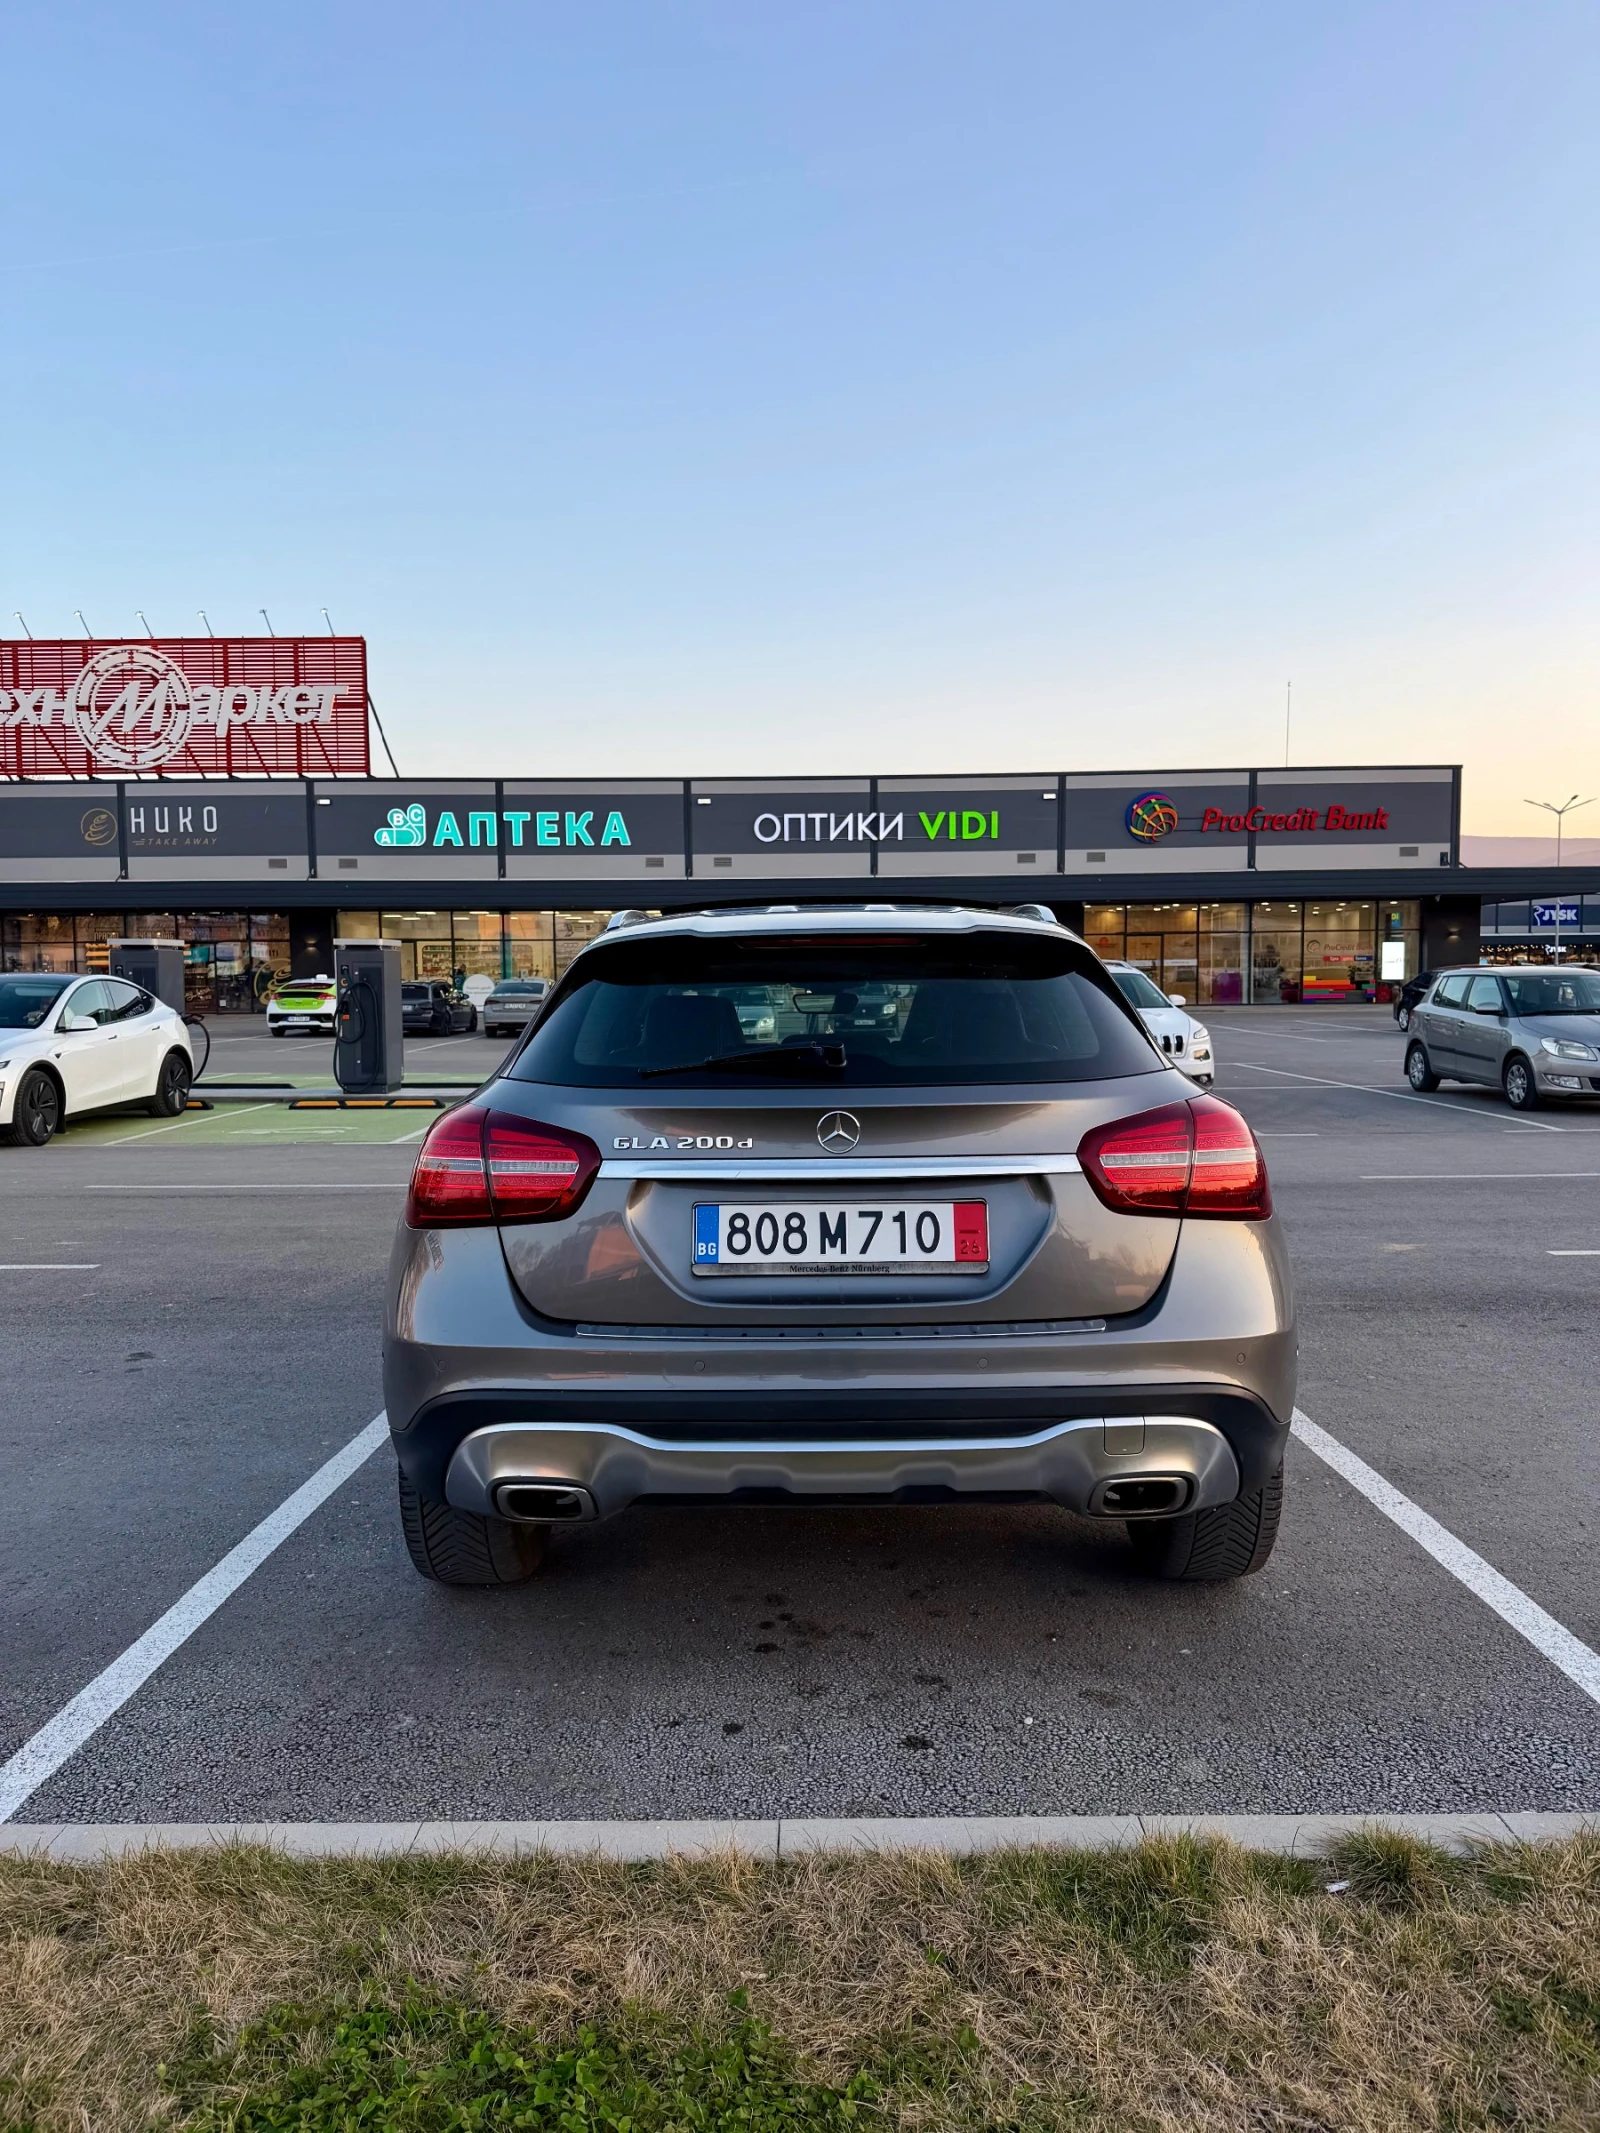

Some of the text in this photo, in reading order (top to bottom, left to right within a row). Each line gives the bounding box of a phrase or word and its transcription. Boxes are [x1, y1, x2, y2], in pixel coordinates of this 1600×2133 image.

[1200, 803, 1390, 833] ProCredit Bank
[432, 811, 632, 847] АПТЕКА
[753, 810, 999, 843] ОПТИКИ VIDI
[148, 838, 178, 846] TAKE
[1542, 908, 1578, 921] JYSK
[613, 1137, 670, 1149] GLA
[698, 1242, 717, 1256] BG
[959, 1239, 982, 1255] 26
[789, 1264, 890, 1273] Mercedes-Benz Nürnberg
